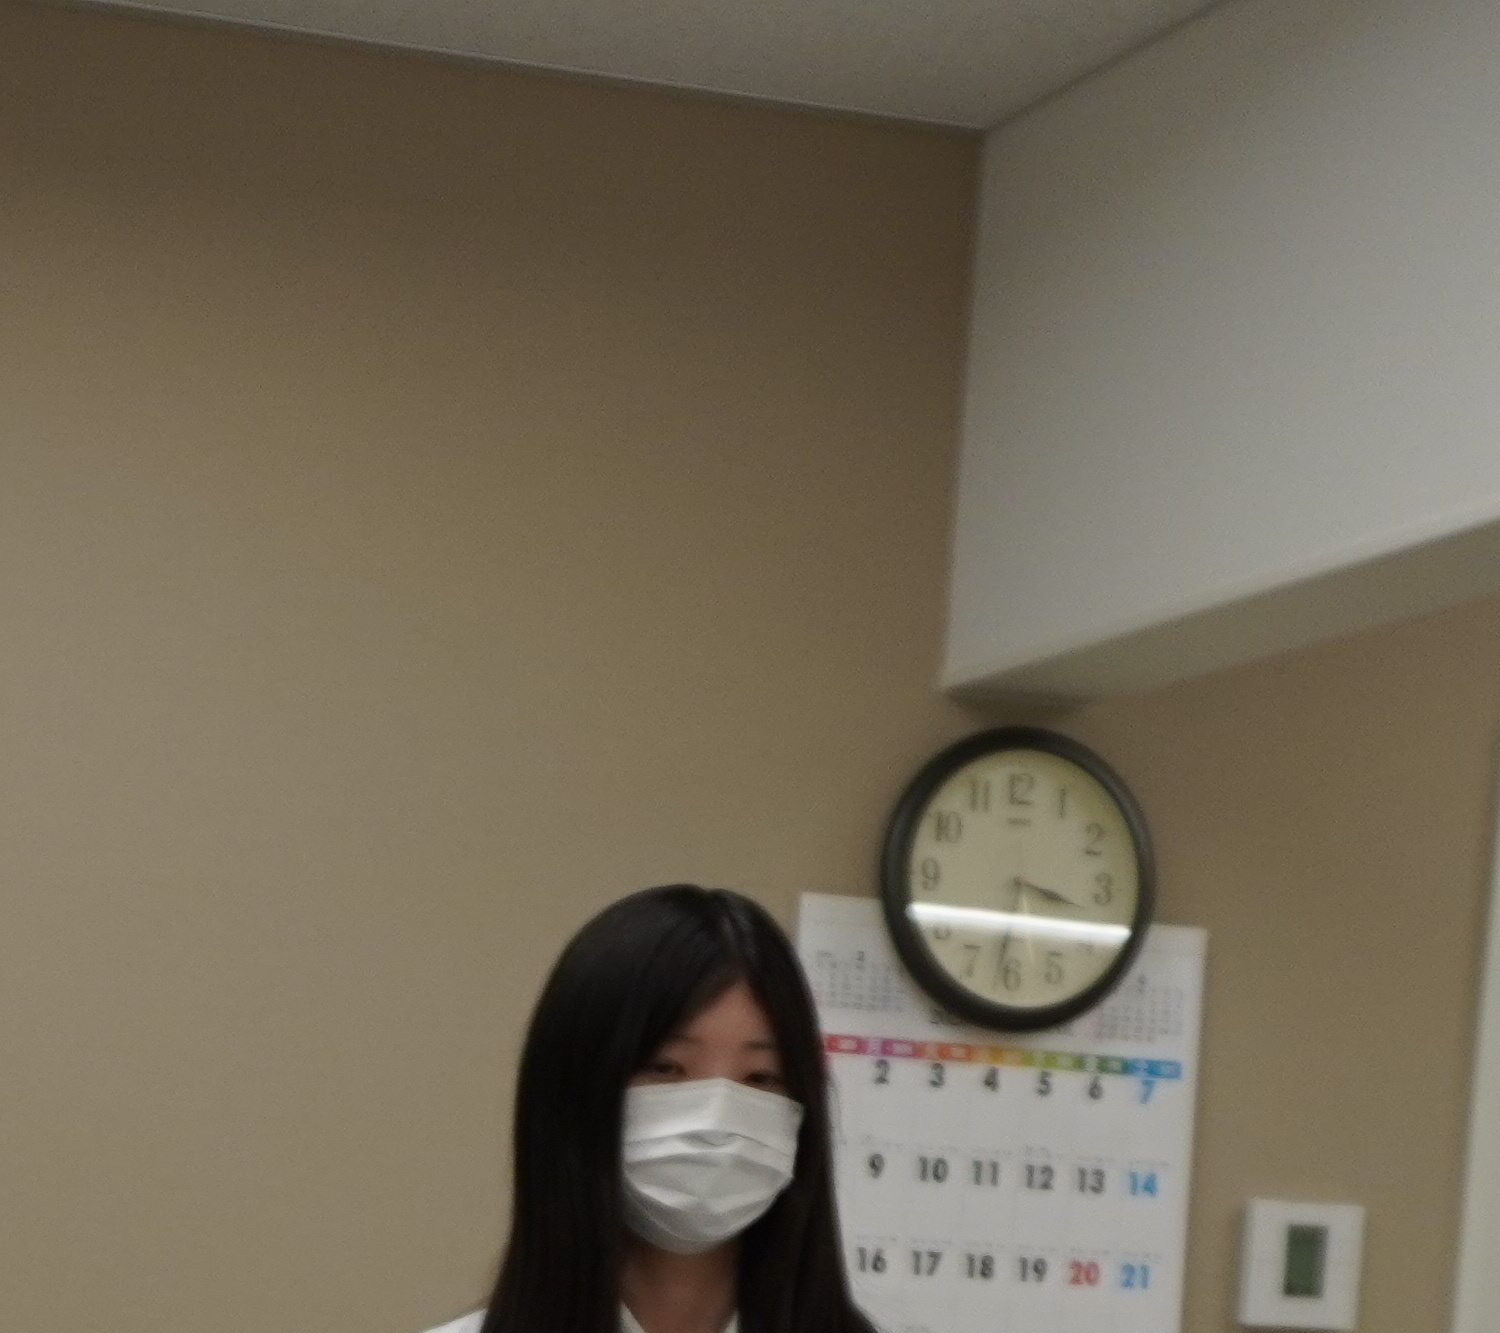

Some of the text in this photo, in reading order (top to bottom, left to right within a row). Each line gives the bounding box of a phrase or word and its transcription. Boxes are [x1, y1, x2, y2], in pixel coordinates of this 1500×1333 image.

[969, 776, 992, 813] 11
[1008, 773, 1034, 806] 12
[1059, 786, 1067, 819] 1
[935, 811, 963, 844] 10
[1085, 823, 1105, 856] 2
[921, 858, 941, 892] 9
[1094, 873, 1113, 905] 3
[963, 944, 981, 978] 7
[1003, 957, 1021, 991] 6
[1044, 950, 1063, 984] 5
[873, 1059, 1156, 1104] 2 3 4 5 6 7
[867, 1153, 1158, 1197] 9 10 11 12 13 14
[856, 1246, 1150, 1290] 16 17 18 19 20 21
